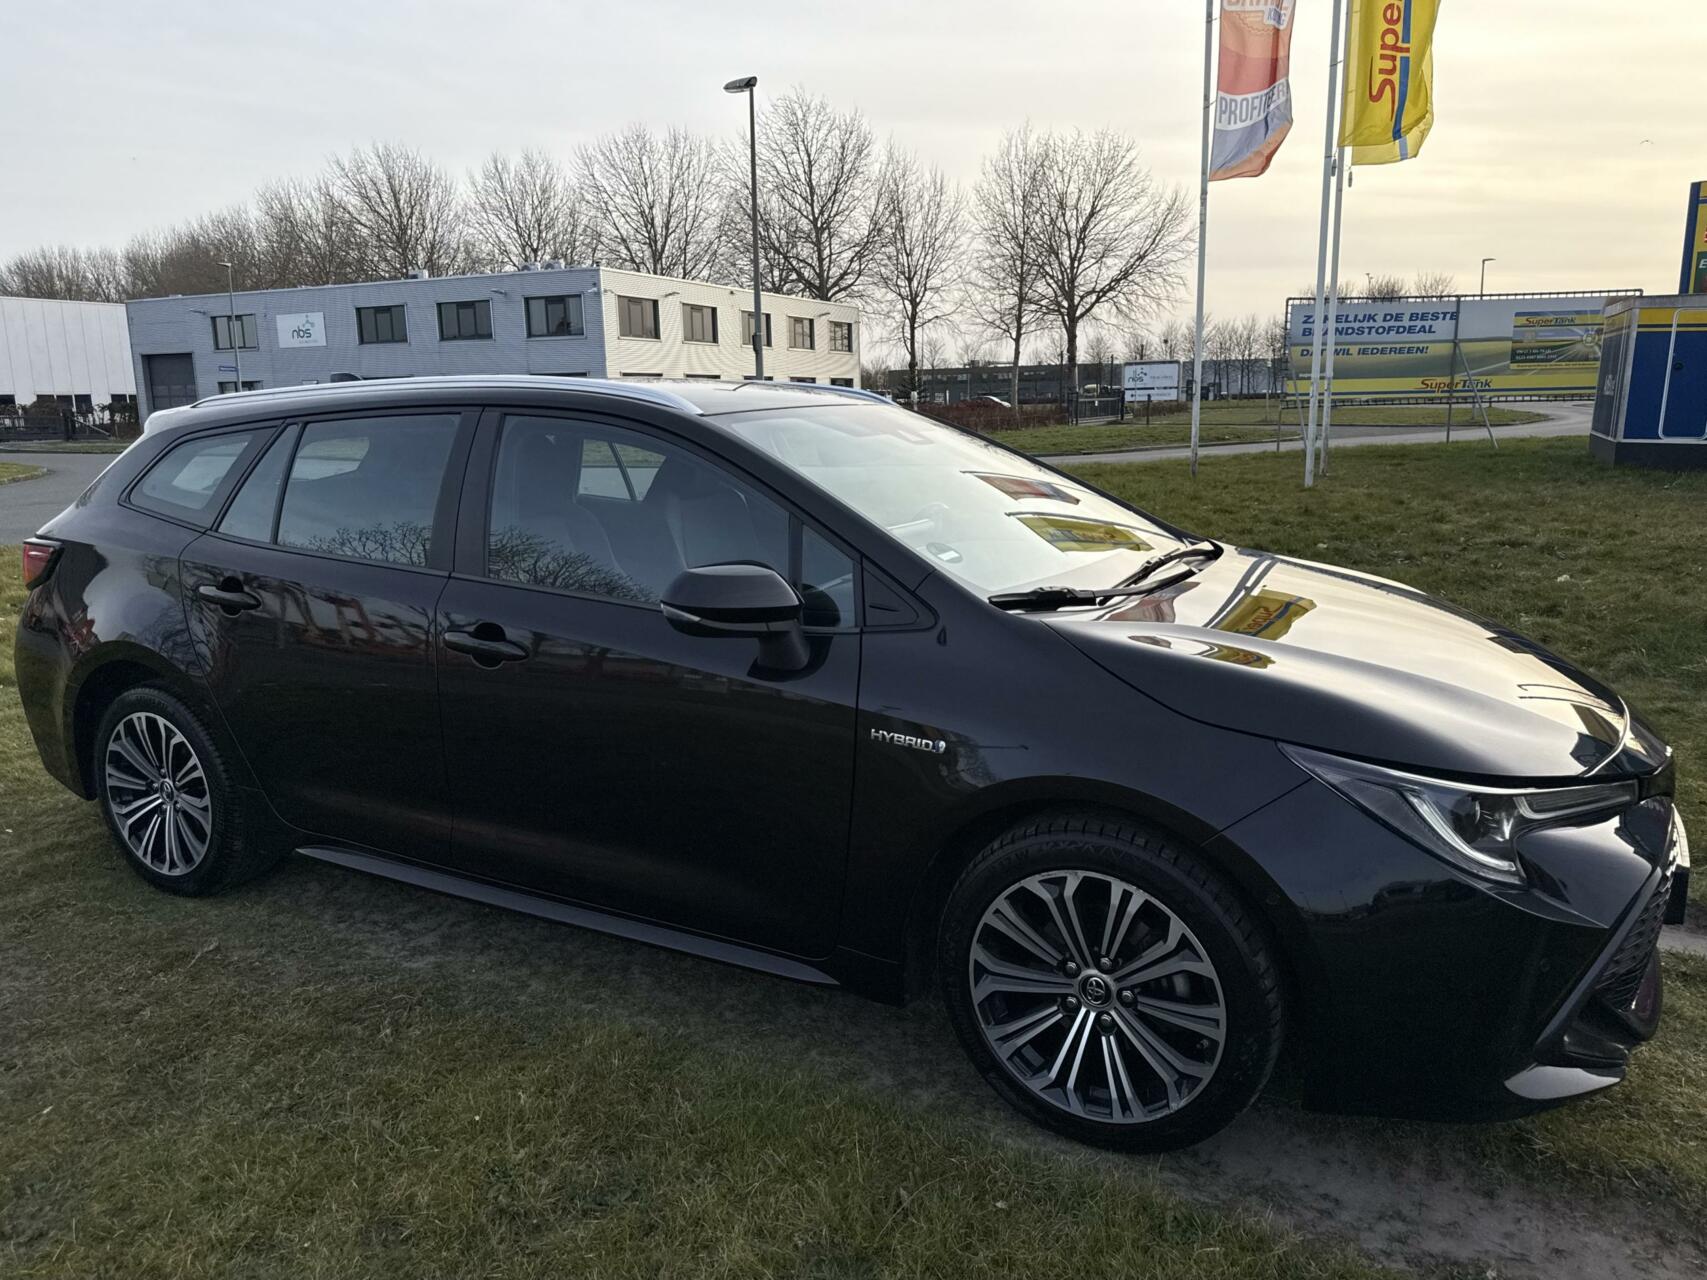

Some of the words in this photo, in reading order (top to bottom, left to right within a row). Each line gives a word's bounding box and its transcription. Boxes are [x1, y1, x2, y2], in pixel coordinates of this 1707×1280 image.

[1302, 313, 1378, 324] ZELIJK
[1382, 313, 1405, 322] DE
[292, 326, 312, 339] nbs
[1301, 325, 1436, 337] BNDSTOFDEAL
[1300, 348, 1327, 357] DT
[1357, 346, 1430, 356] IEDEREEN!
[870, 728, 934, 751] HYBRID
